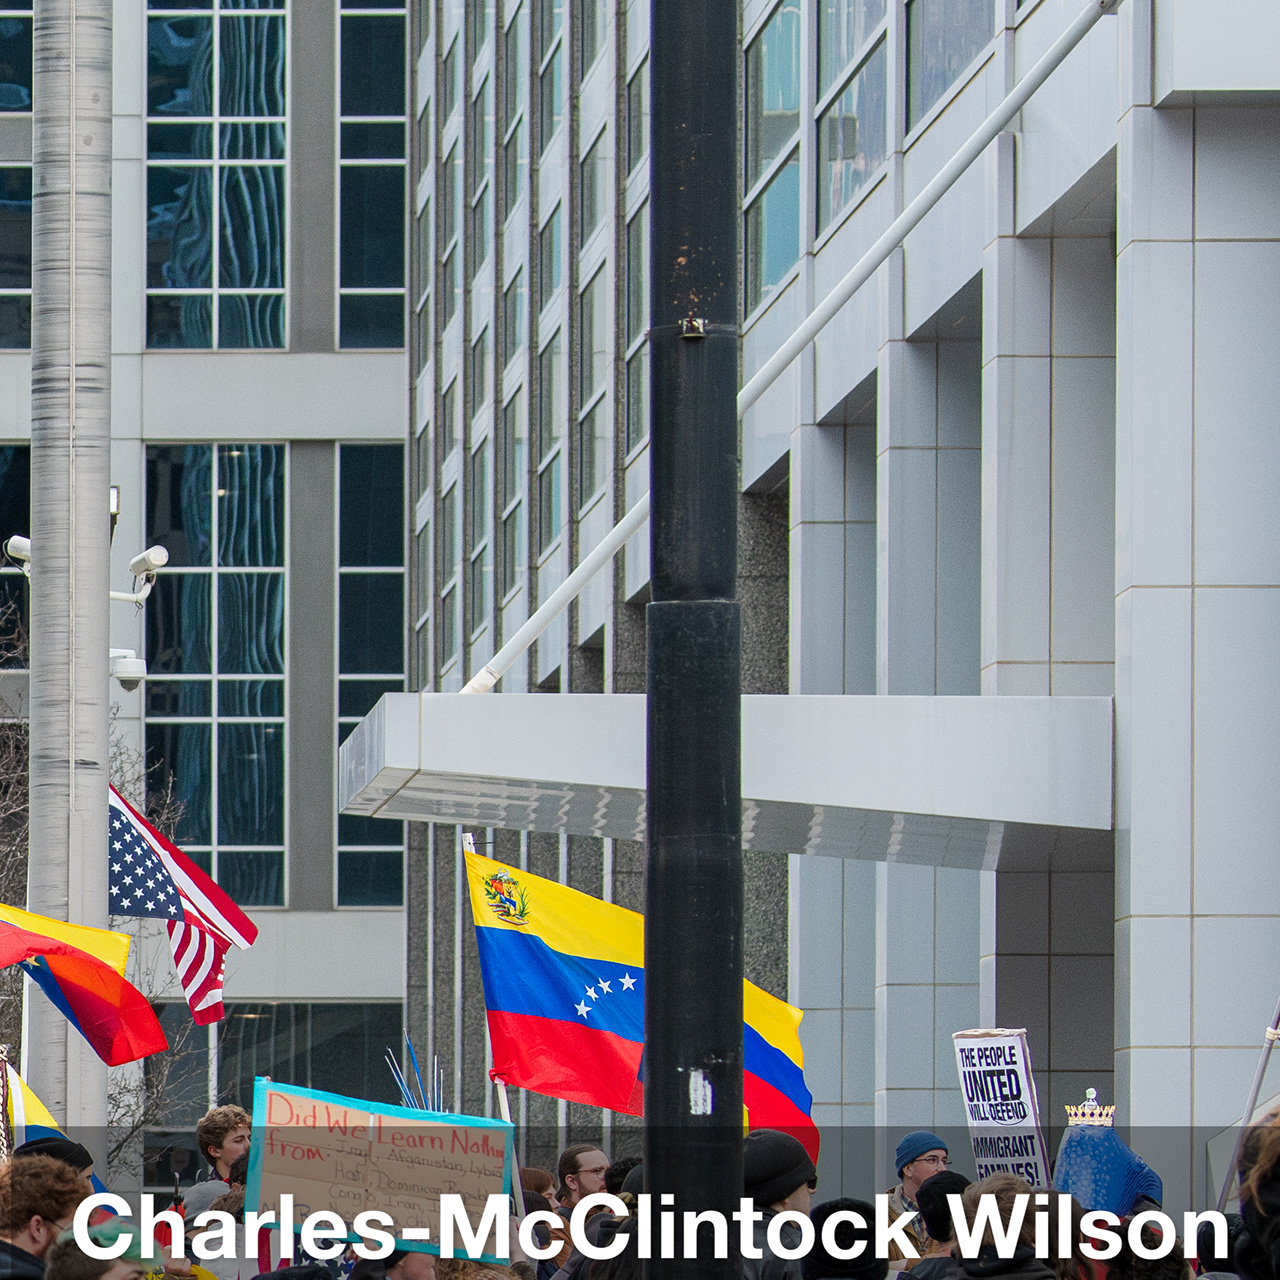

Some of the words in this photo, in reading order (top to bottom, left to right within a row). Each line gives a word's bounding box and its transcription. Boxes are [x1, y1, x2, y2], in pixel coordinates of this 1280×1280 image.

[959, 1047, 977, 1067] THE
[978, 1045, 1017, 1067] PEOPLE
[962, 1068, 1022, 1103] UNITED
[266, 1092, 317, 1130] Did
[325, 1105, 367, 1141] We
[377, 1114, 444, 1150] Learn
[968, 1103, 990, 1121] WILL
[990, 1101, 1027, 1122] DEFEND
[972, 1134, 1036, 1159] IMMIGRANT
